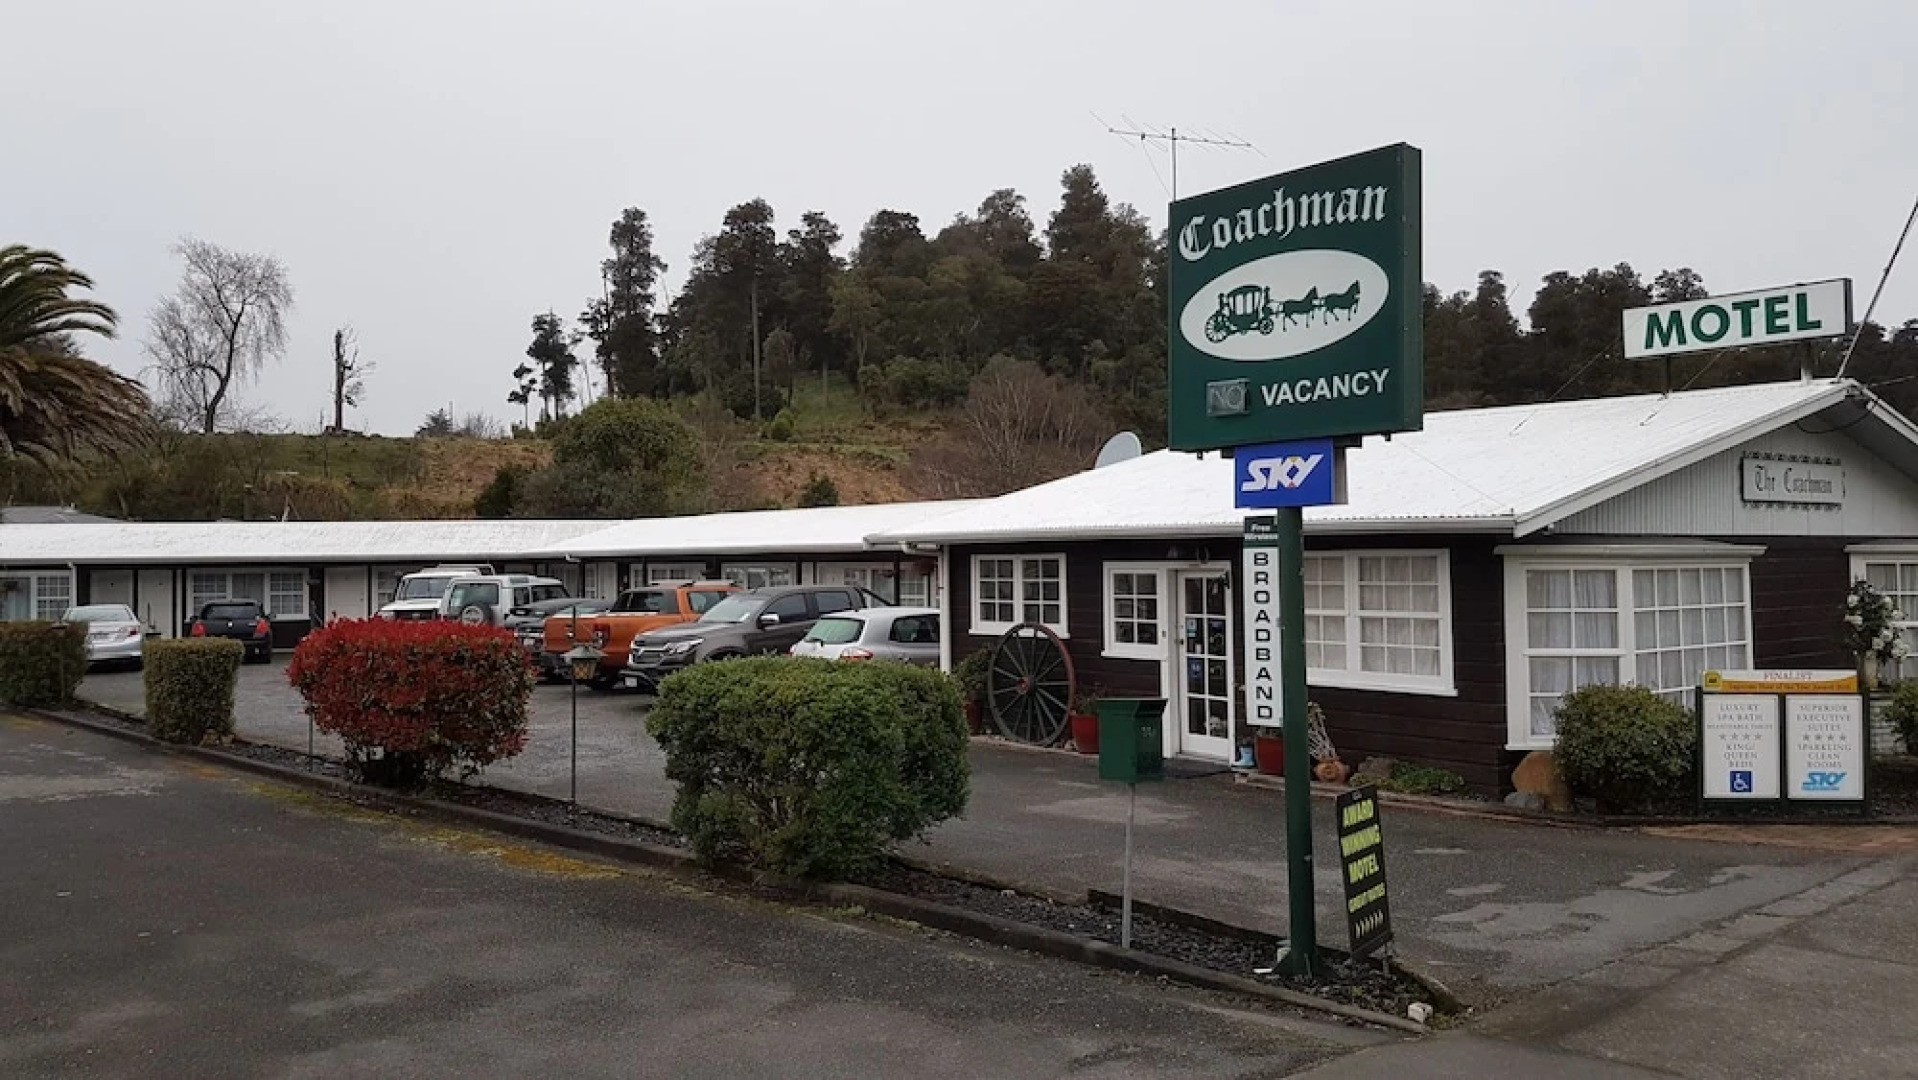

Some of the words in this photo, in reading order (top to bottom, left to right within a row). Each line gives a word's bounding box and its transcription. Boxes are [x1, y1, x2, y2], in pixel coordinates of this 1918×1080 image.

[1178, 185, 1388, 262] Coachman
[1644, 292, 1822, 350] MOTEL
[1209, 383, 1247, 408] NO
[1261, 367, 1390, 406] VACANCY
[1241, 454, 1324, 491] SKY
[1755, 464, 1775, 492] The
[1253, 552, 1273, 720] BROADBAND
[1763, 671, 1813, 680] FINALIST
[1718, 713, 1735, 721] SPA
[1737, 713, 1763, 721] BATH
[1797, 714, 1851, 722] EXECUTIVE
[1723, 752, 1758, 760] QUEEN
[1802, 771, 1847, 786] SKY
[1348, 852, 1379, 884] MOTEL
